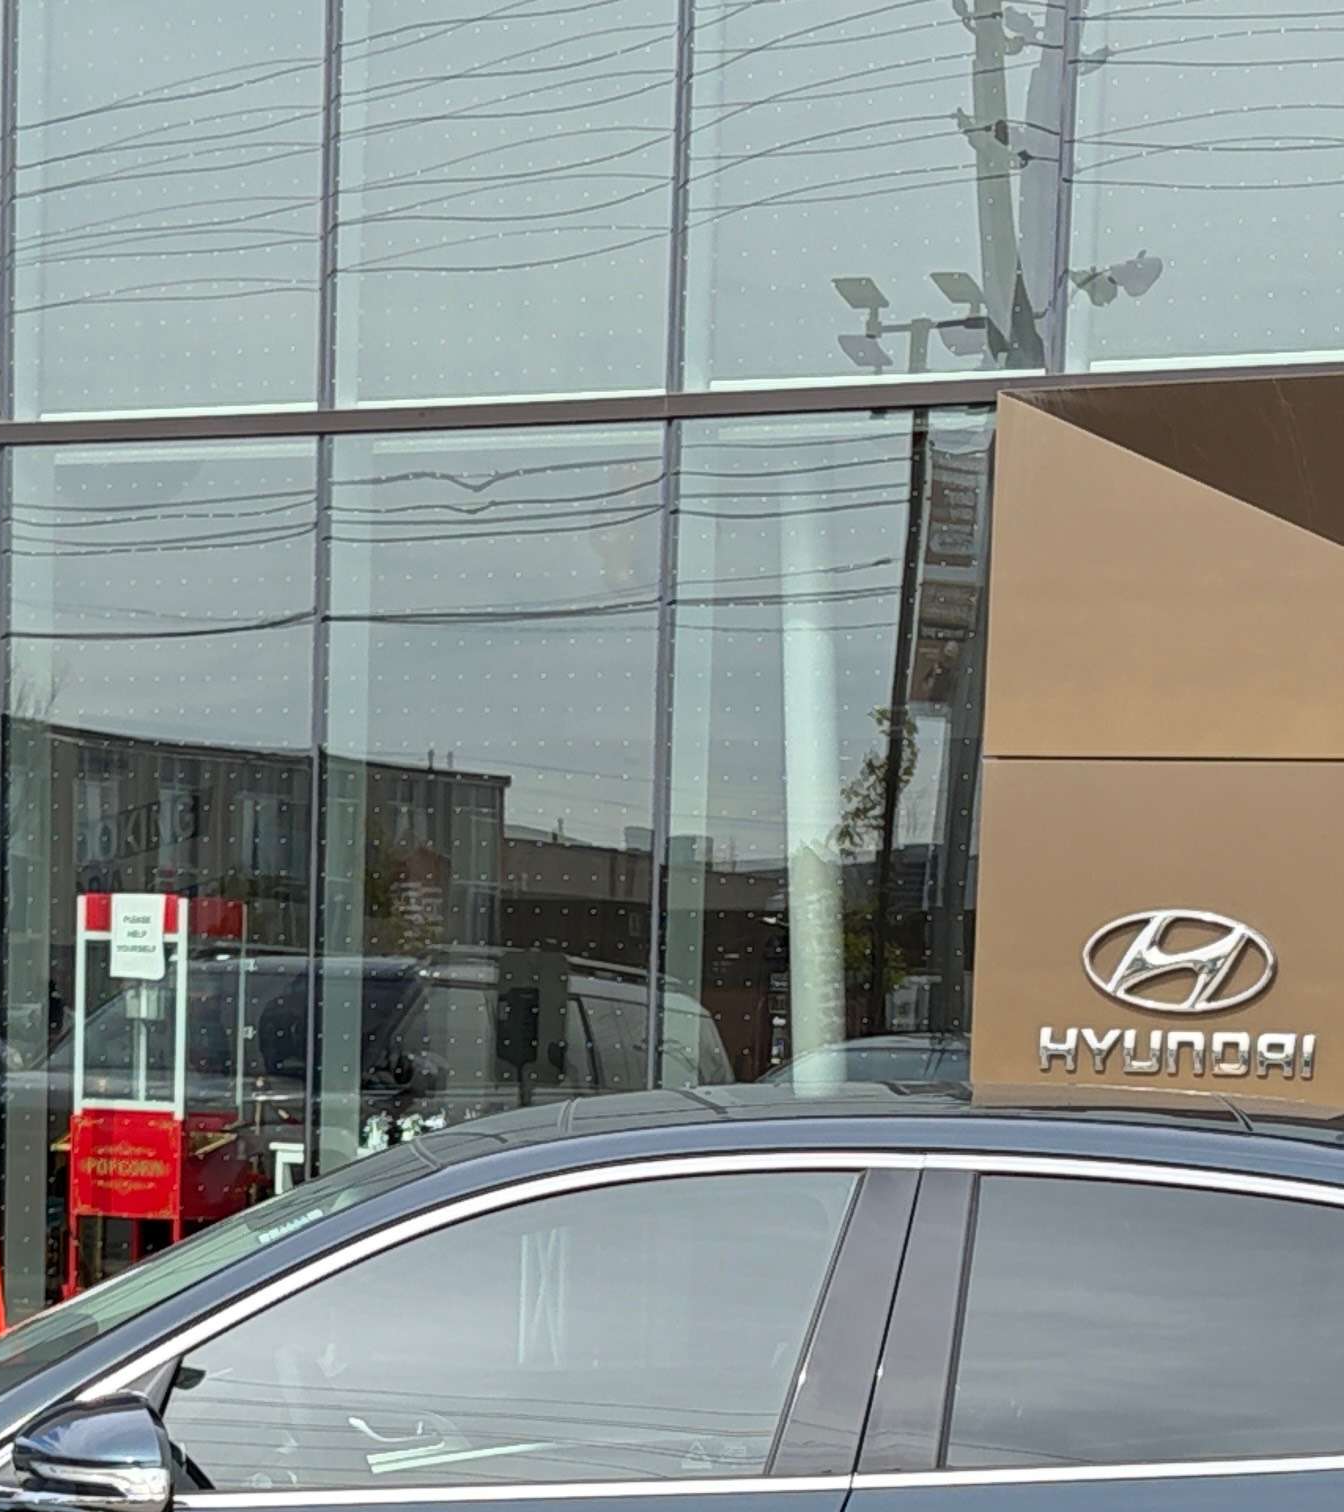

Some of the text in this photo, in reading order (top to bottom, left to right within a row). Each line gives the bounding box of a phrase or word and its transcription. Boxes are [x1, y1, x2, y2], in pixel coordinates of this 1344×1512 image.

[122, 915, 152, 924] PLEASE
[126, 930, 148, 938] HELP
[116, 944, 157, 953] YOURSELF
[1040, 1026, 1316, 1080] HYUNDAI
[85, 1157, 165, 1178] POPCORN
